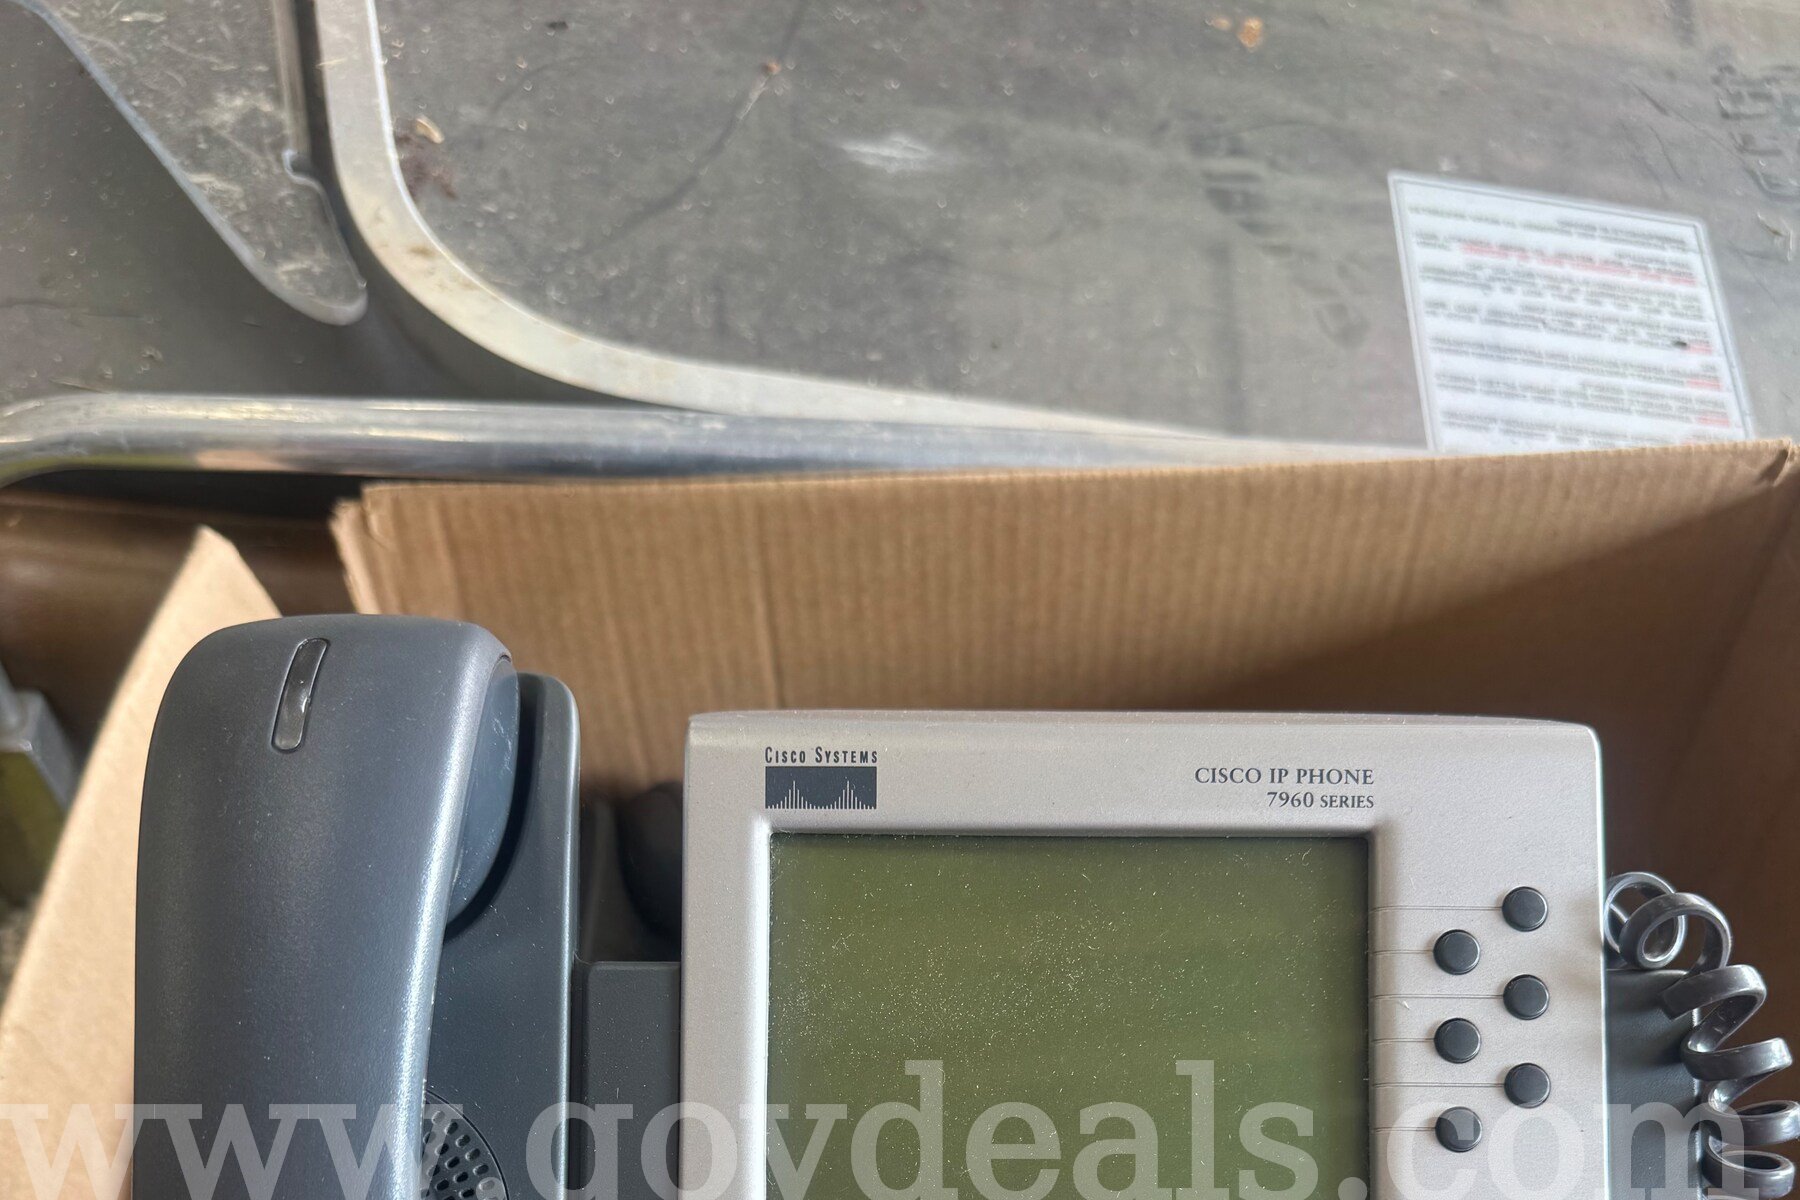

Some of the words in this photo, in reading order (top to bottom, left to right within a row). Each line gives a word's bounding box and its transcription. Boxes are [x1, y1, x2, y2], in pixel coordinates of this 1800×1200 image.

[1194, 767, 1262, 784] CISCO
[1269, 767, 1289, 784] IP
[1295, 768, 1375, 785] PHONE
[1266, 791, 1315, 808] 7960
[1319, 794, 1375, 809] SERIES
